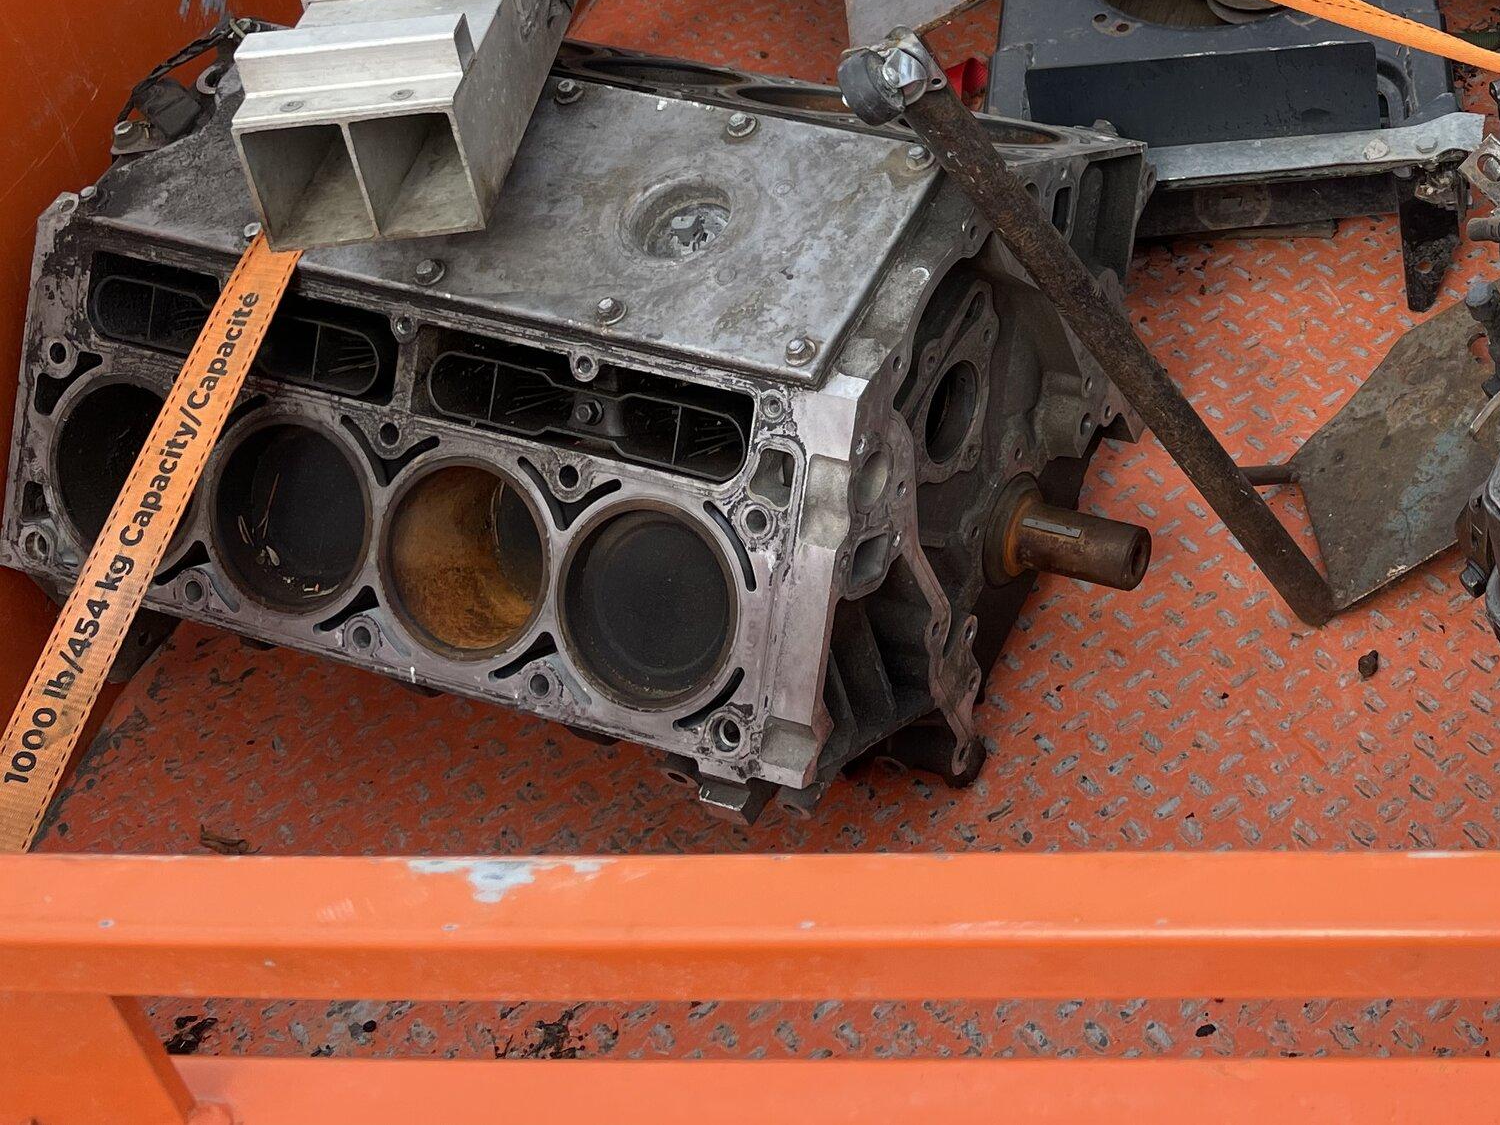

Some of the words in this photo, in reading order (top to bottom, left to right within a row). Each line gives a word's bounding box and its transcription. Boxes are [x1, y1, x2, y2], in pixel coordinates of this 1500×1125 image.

[4, 706, 57, 784] 1000
[42, 598, 111, 699] lb/454
[95, 554, 135, 591] kg
[119, 291, 259, 546] Capacity/Capacité
